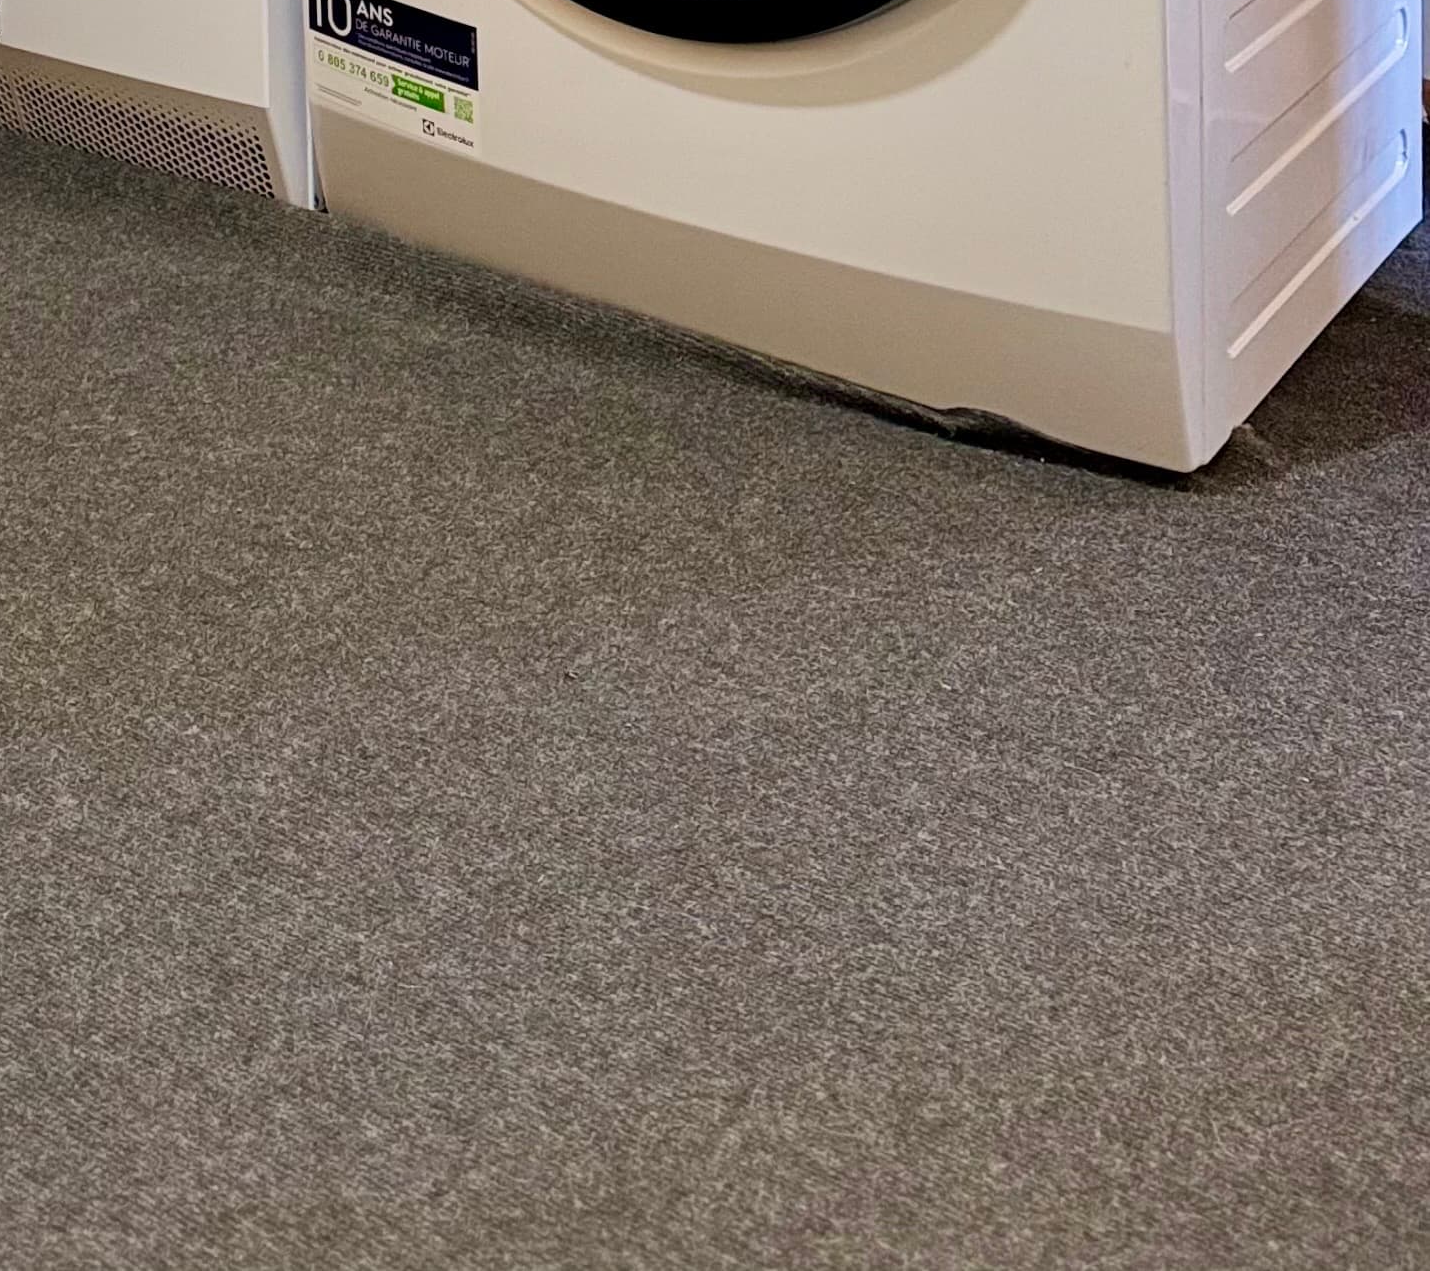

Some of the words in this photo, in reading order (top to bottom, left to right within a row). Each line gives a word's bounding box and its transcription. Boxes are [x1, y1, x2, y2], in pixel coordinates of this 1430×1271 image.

[356, 0, 394, 27] ANS
[356, 18, 369, 33] DE
[371, 24, 422, 52] GARANTIE
[424, 43, 471, 69] MOTEUR
[318, 49, 325, 62] 0
[327, 52, 346, 71] 805
[349, 62, 367, 79] 374
[370, 71, 390, 87] 659
[437, 126, 474, 148] Electrolux
